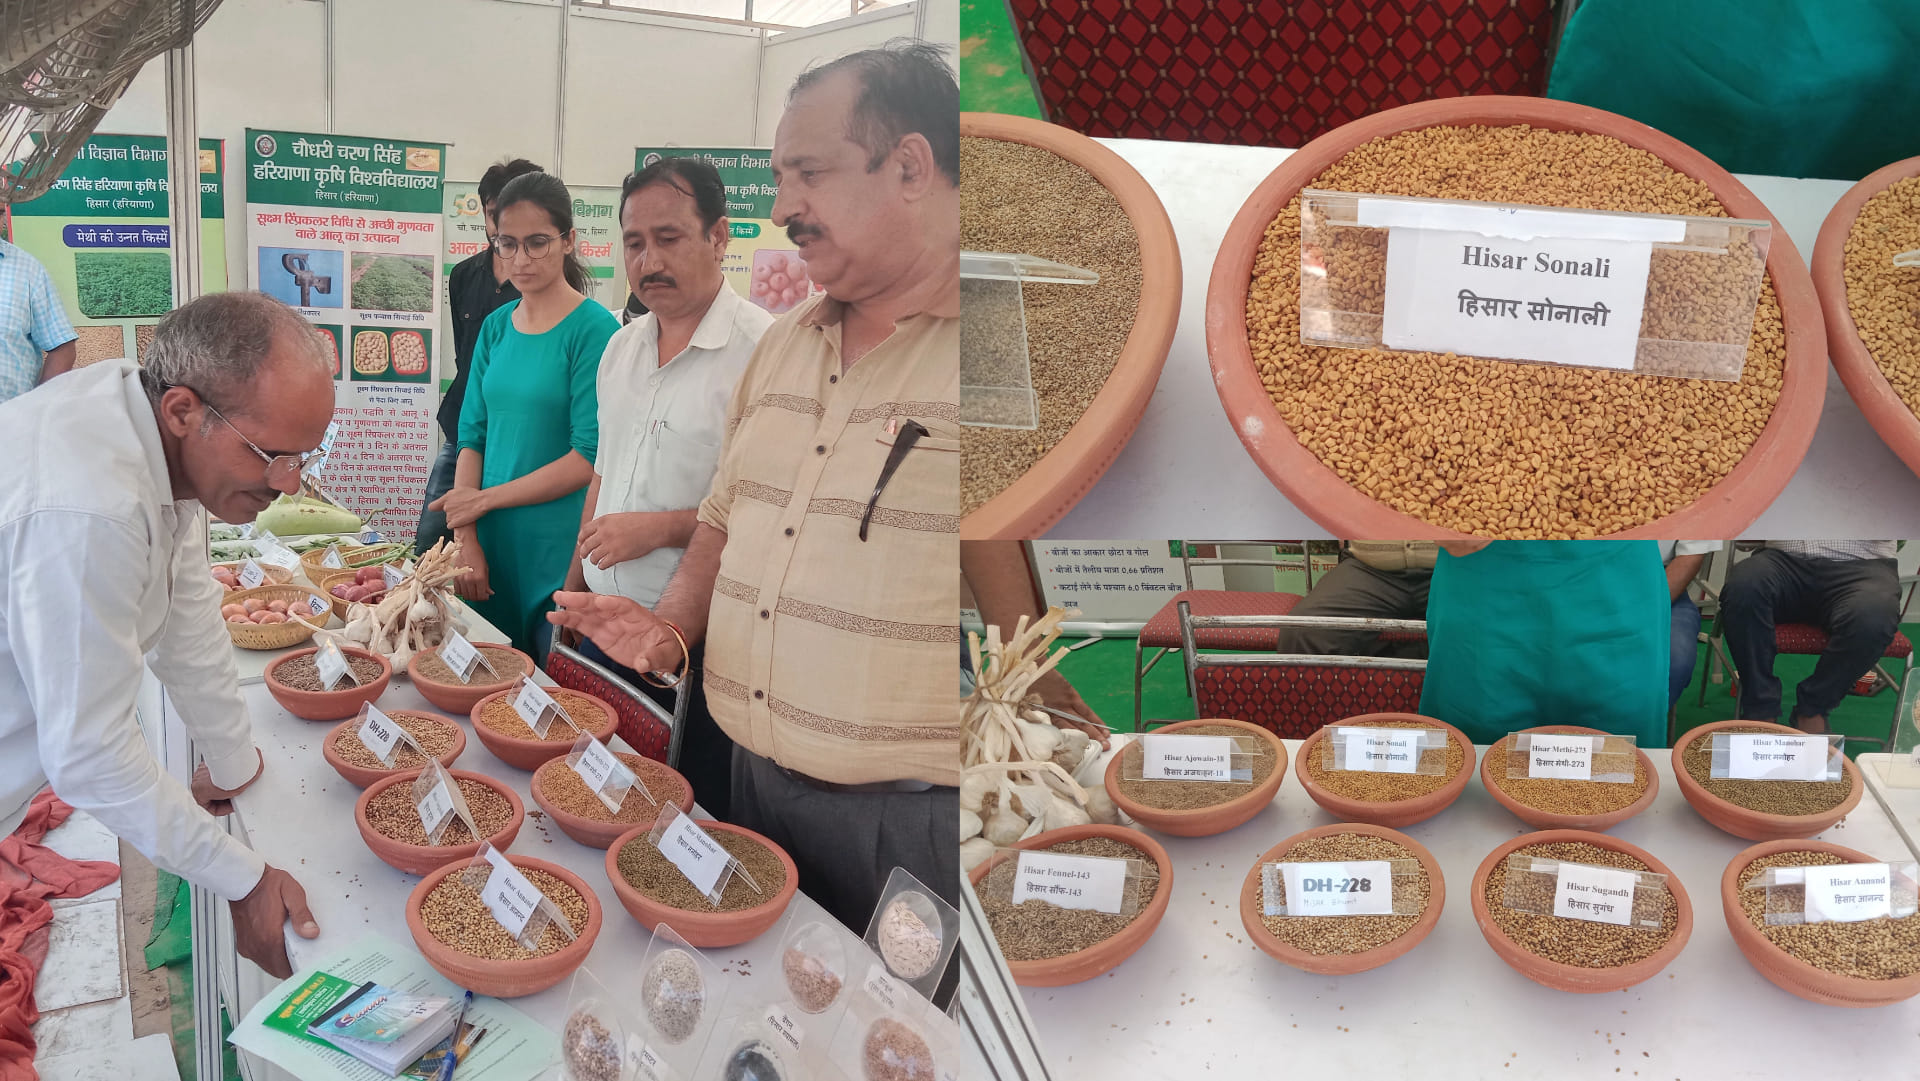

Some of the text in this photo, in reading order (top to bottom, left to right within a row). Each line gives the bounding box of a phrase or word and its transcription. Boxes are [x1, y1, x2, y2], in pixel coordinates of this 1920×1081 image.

[88, 144, 127, 161] विज्ञान
[292, 137, 402, 165] चौधरी चरण सिंह
[253, 160, 438, 190] हरियाणा कृषि विश्वविद्यालय
[72, 176, 157, 196] सिंह हरियाणा कृषि
[740, 184, 759, 198] कृषि
[315, 189, 338, 201] हिसार
[86, 197, 154, 211] हिसार (हरियाणा)
[573, 198, 614, 218] विभाग
[256, 213, 282, 227] सूक्ष्म
[331, 215, 354, 228] विधि
[356, 216, 366, 229] से
[369, 218, 395, 230] अच्छी
[76, 229, 168, 243] मेथी की उन्नत किस्में
[295, 228, 400, 244] वाले आलू का उत्पादन
[1462, 244, 1611, 279] Hisar Sonali
[1457, 288, 1612, 327] हिसार सोनाली
[401, 410, 419, 419] आलू
[375, 441, 389, 450] दिन
[360, 451, 375, 460] दिन
[341, 462, 355, 471] दिन
[393, 465, 403, 473] पर
[364, 475, 376, 483] एक
[381, 518, 394, 527] दिन
[1083, 549, 1105, 557] आकार
[1366, 738, 1385, 746] Hisar
[1532, 744, 1550, 753] Hisar
[1753, 738, 1772, 746] Hisar
[1535, 757, 1554, 767] हिसार
[1164, 766, 1182, 776] हिसार
[1024, 865, 1090, 880] Hisar Fennel-143
[1026, 881, 1048, 893] हिसार
[1303, 877, 1372, 893] DH-228
[1830, 878, 1852, 887] Hisar
[1566, 881, 1629, 898] Hisar Sugandh
[1834, 894, 1857, 904] हिसार
[1567, 897, 1615, 915] हिसार सुगंध
